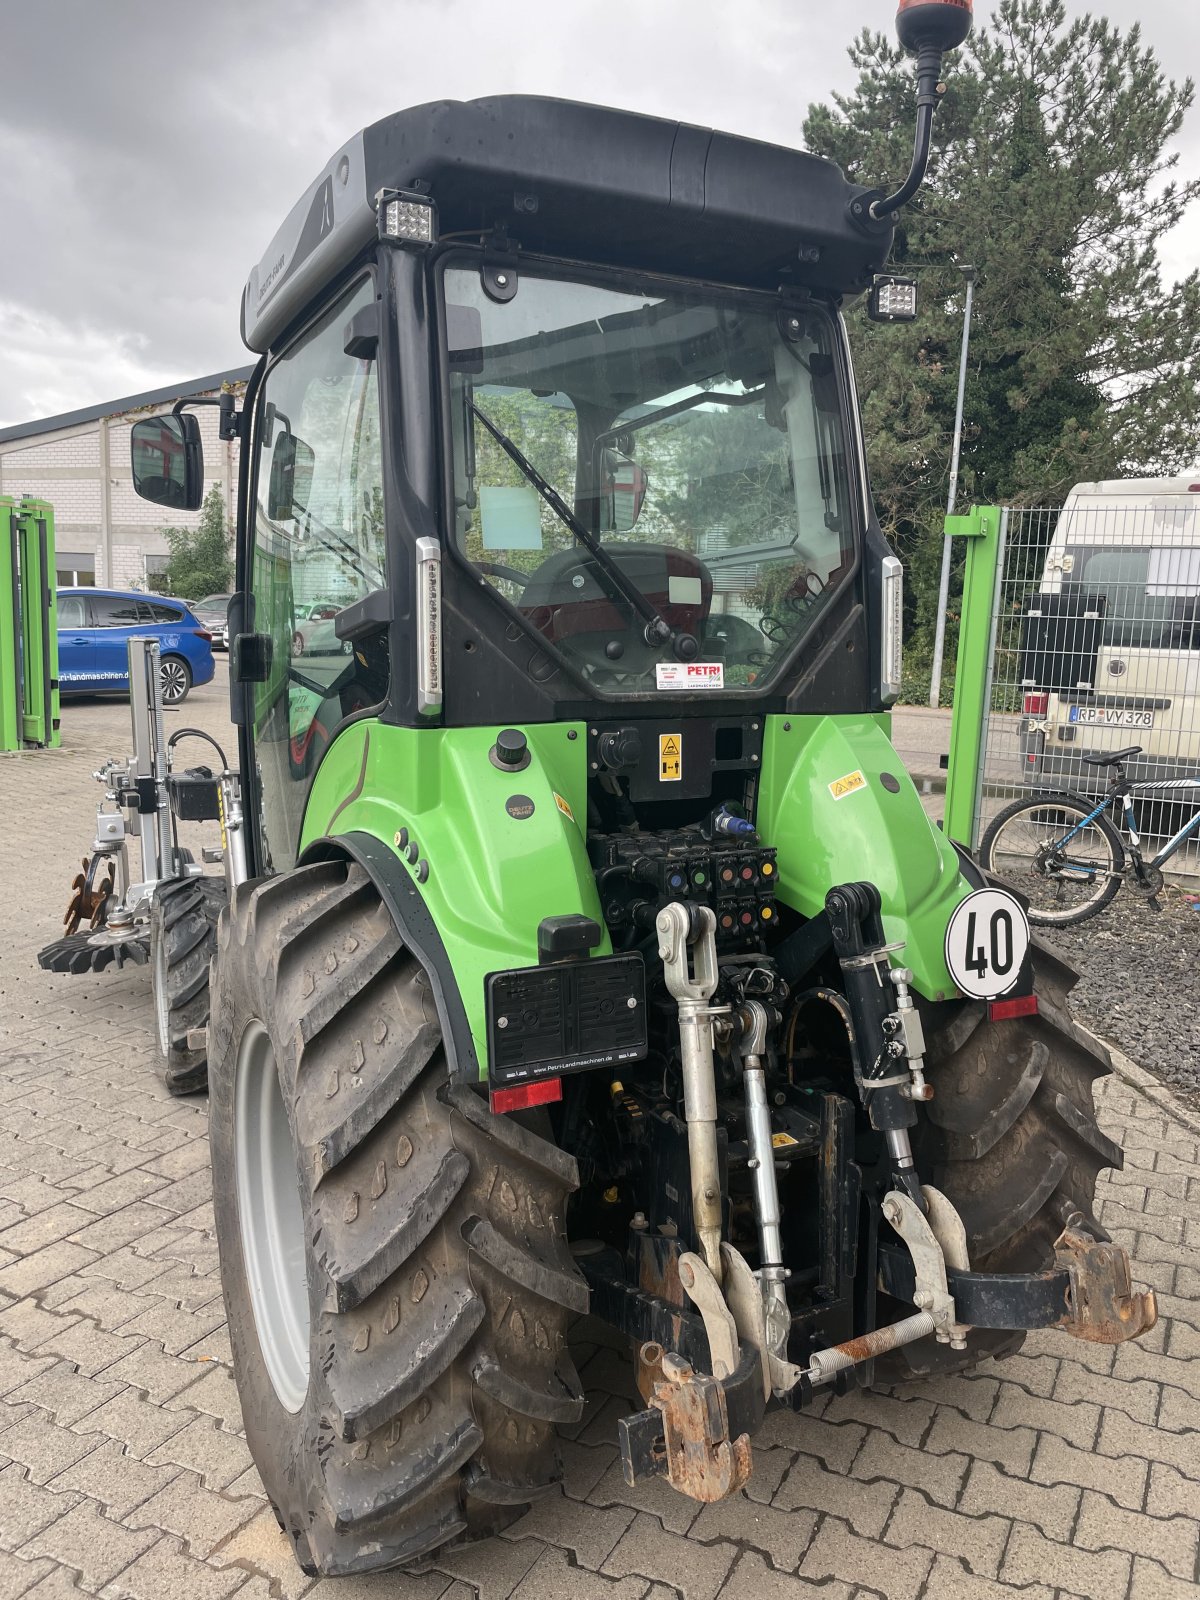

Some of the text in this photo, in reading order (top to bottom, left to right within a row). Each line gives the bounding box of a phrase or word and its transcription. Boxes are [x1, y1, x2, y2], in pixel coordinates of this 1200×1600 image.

[687, 666, 720, 676] PETRI
[1078, 708, 1152, 725] RP VY 378
[965, 908, 1014, 980] 40
